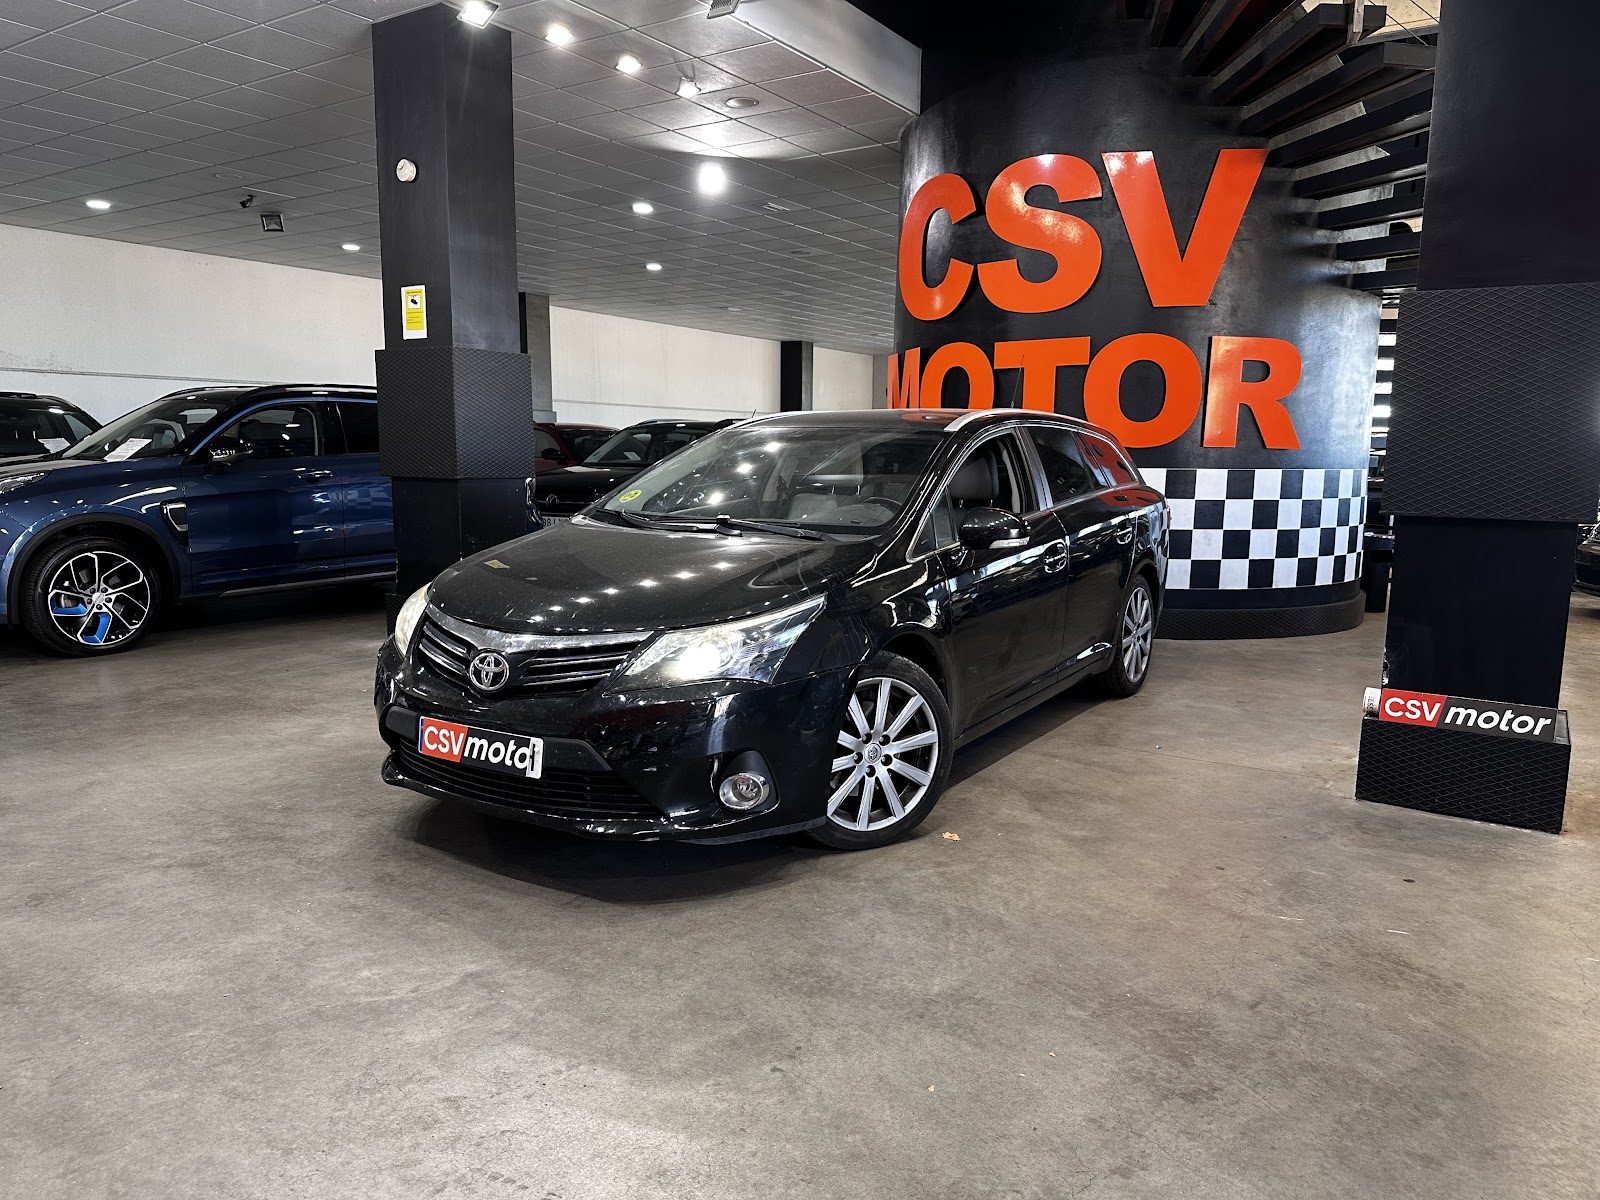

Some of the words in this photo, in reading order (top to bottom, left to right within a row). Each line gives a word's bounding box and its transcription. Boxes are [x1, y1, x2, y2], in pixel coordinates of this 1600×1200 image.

[899, 148, 1270, 321] CSV
[887, 333, 1303, 450] MOTOR
[463, 736, 532, 769] moto
